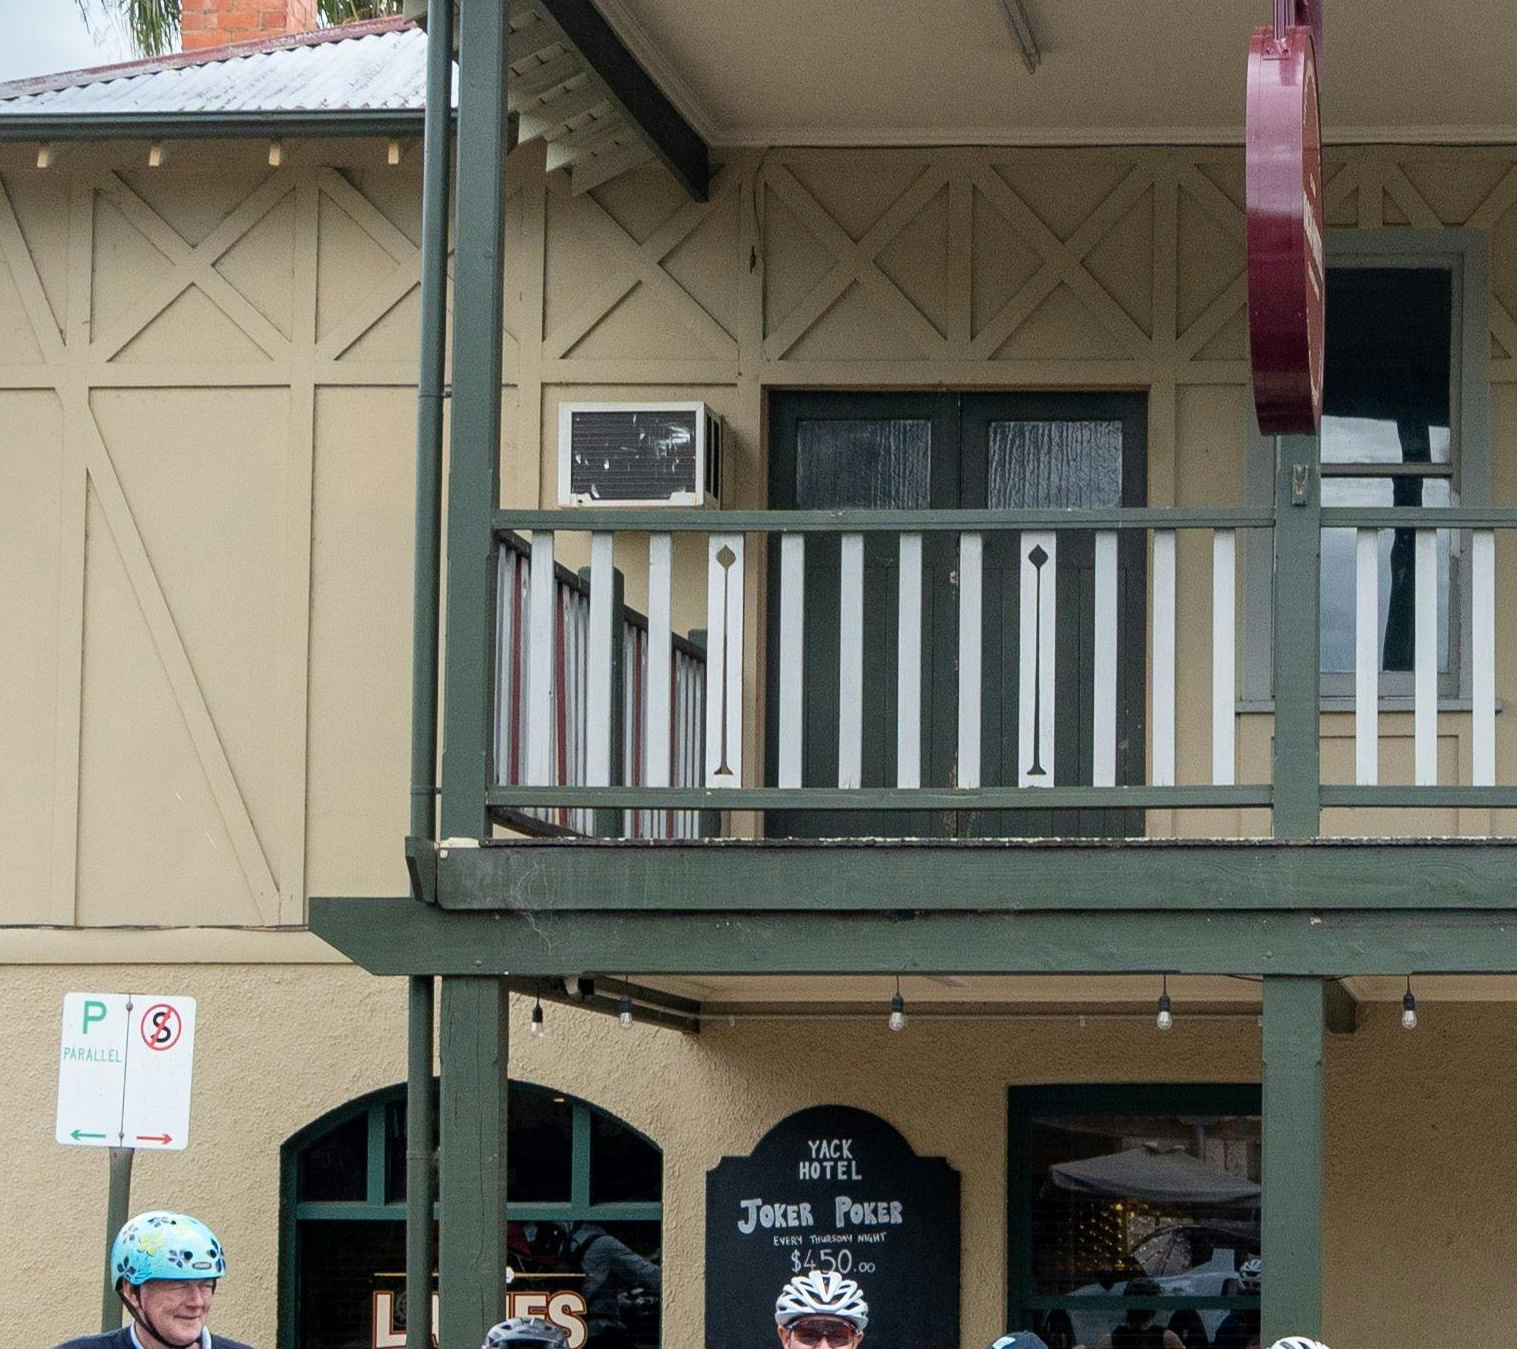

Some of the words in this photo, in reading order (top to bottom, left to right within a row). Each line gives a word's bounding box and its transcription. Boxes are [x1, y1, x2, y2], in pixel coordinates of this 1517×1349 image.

[83, 1000, 107, 1034] P
[63, 1046, 122, 1063] PARALLEL
[808, 1138, 853, 1159] YACK
[799, 1160, 862, 1180] HOTEL
[738, 1197, 814, 1234] JOKER
[835, 1195, 903, 1228] POKER
[773, 1235, 803, 1246] EVERY
[857, 1231, 887, 1243] NIGHT
